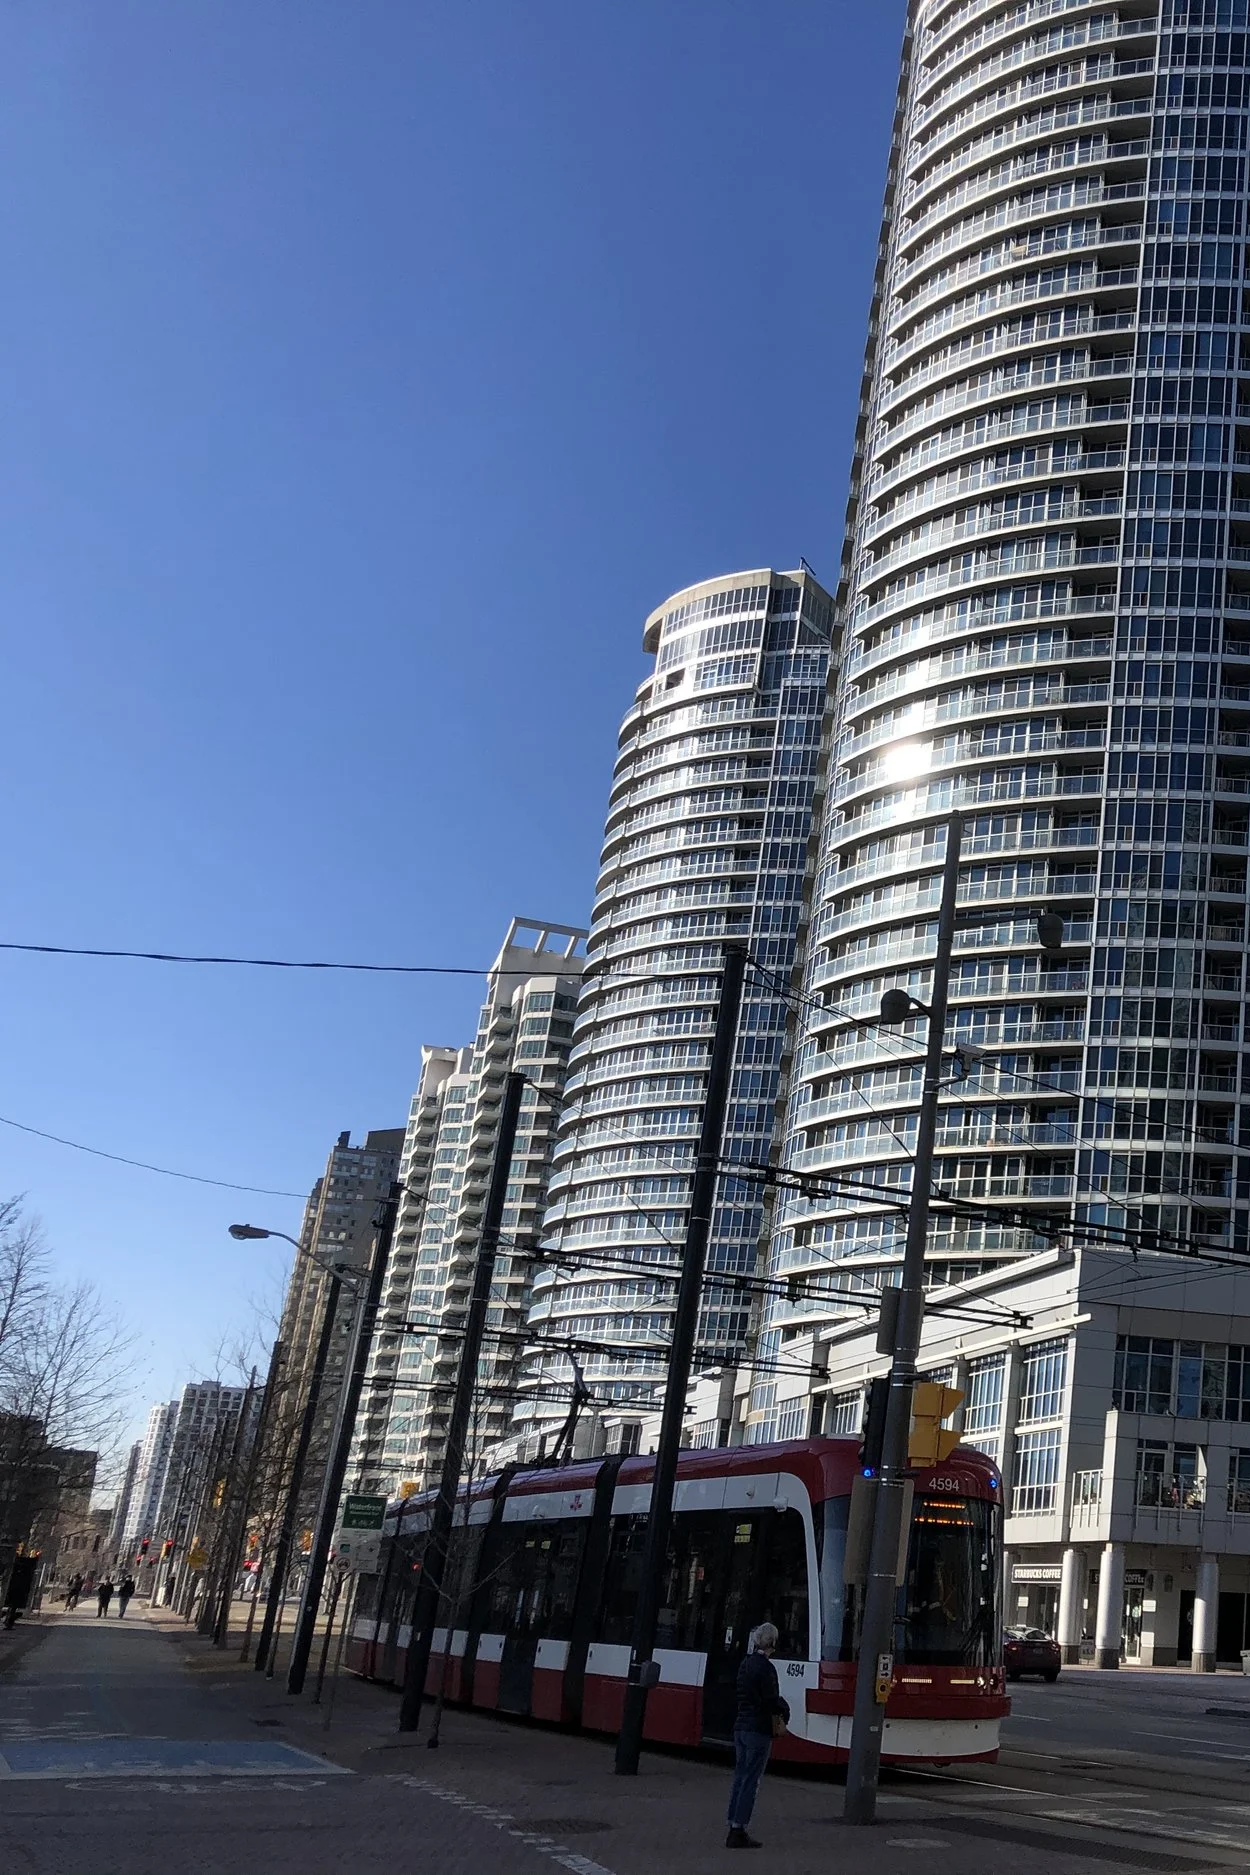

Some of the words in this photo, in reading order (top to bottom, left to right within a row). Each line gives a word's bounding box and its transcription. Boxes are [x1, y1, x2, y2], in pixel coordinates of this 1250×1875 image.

[929, 1477, 960, 1492] 4594
[1014, 1568, 1042, 1579] STARBUCKS
[1042, 1568, 1061, 1579] COFFEE
[786, 1663, 805, 1678] 4594
